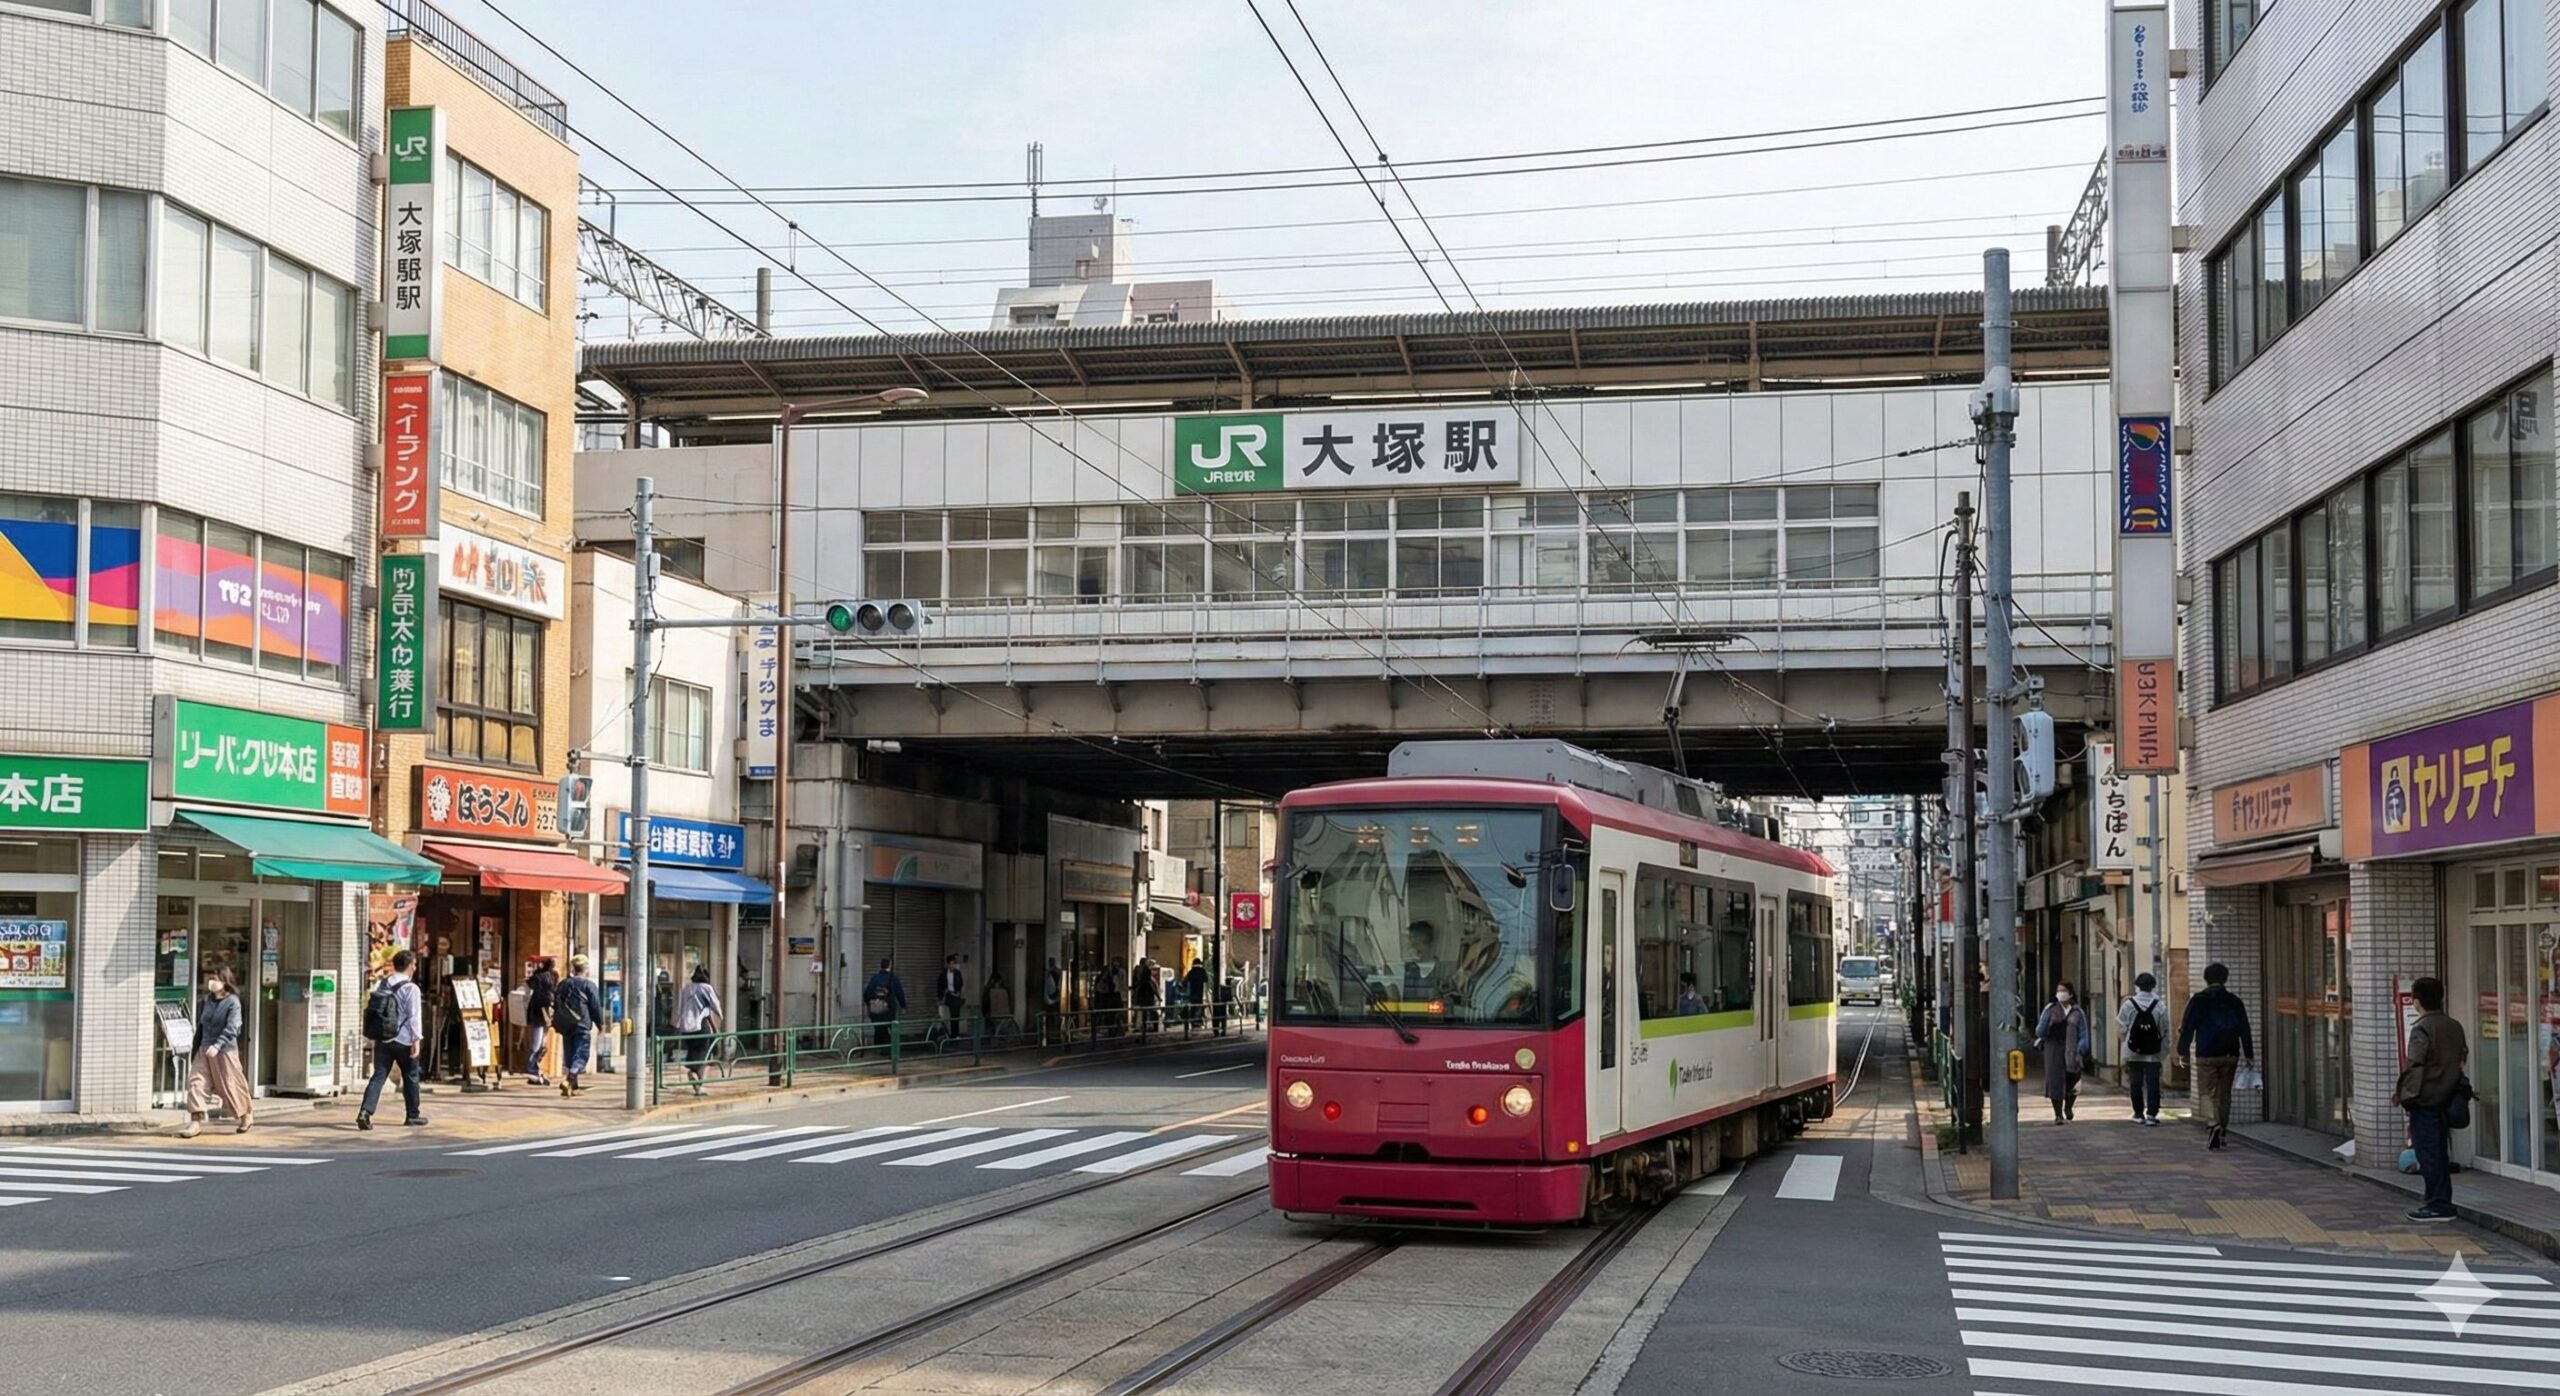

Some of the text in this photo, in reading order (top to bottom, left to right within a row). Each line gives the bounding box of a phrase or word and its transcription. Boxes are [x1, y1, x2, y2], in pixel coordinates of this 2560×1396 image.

[395, 137, 427, 156] JR
[1191, 424, 1267, 468] JR
[1302, 419, 1498, 477] 大塚駅
[0, 772, 84, 814] 本店
